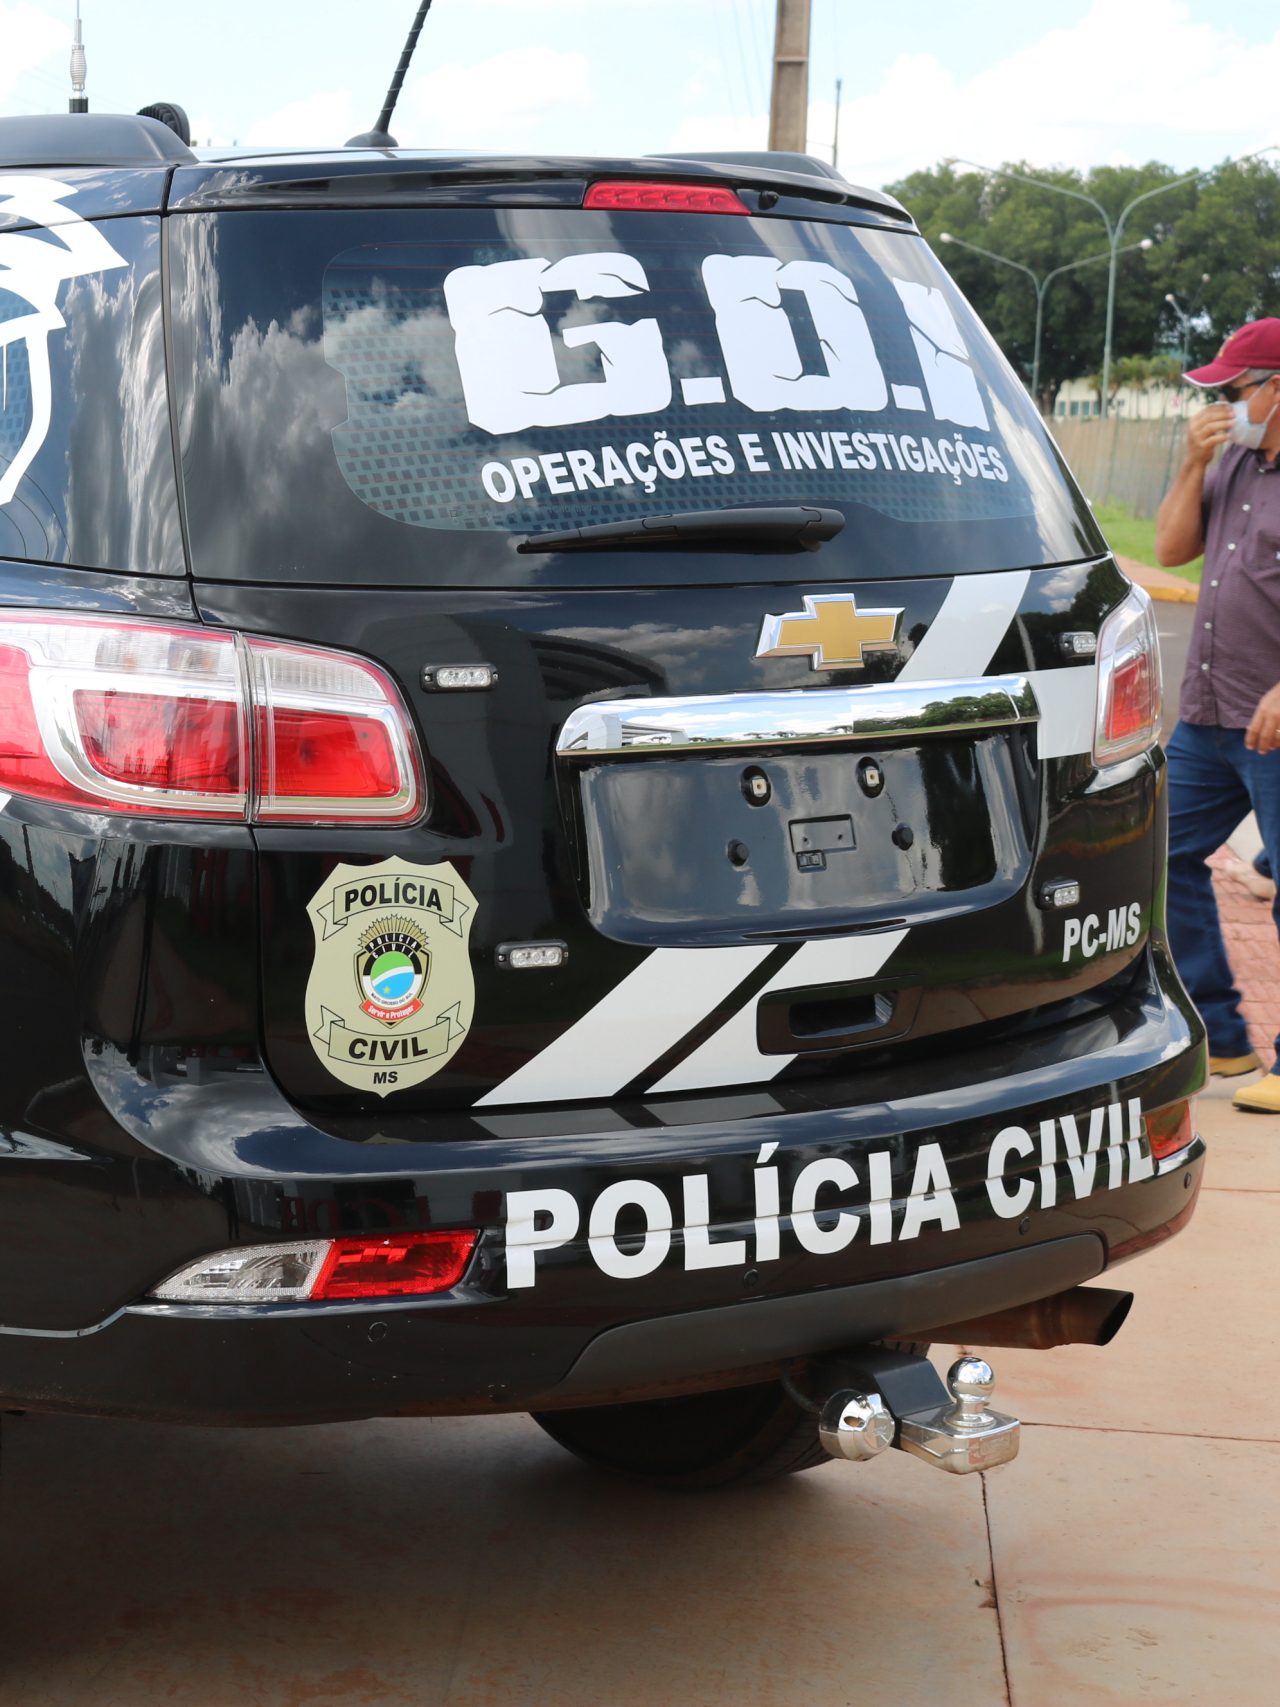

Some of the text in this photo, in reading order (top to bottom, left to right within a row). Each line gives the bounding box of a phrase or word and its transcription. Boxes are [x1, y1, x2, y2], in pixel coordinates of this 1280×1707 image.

[481, 431, 1009, 504] OPERAÇÕES E INVESTIGAÇÕES
[344, 877, 443, 913] POLÍCIA
[1062, 902, 1141, 963] PC-MS
[348, 1036, 429, 1061] CIVIL
[372, 1071, 398, 1085] MS
[505, 1097, 1155, 1290] POLÍCIA CIVIL
